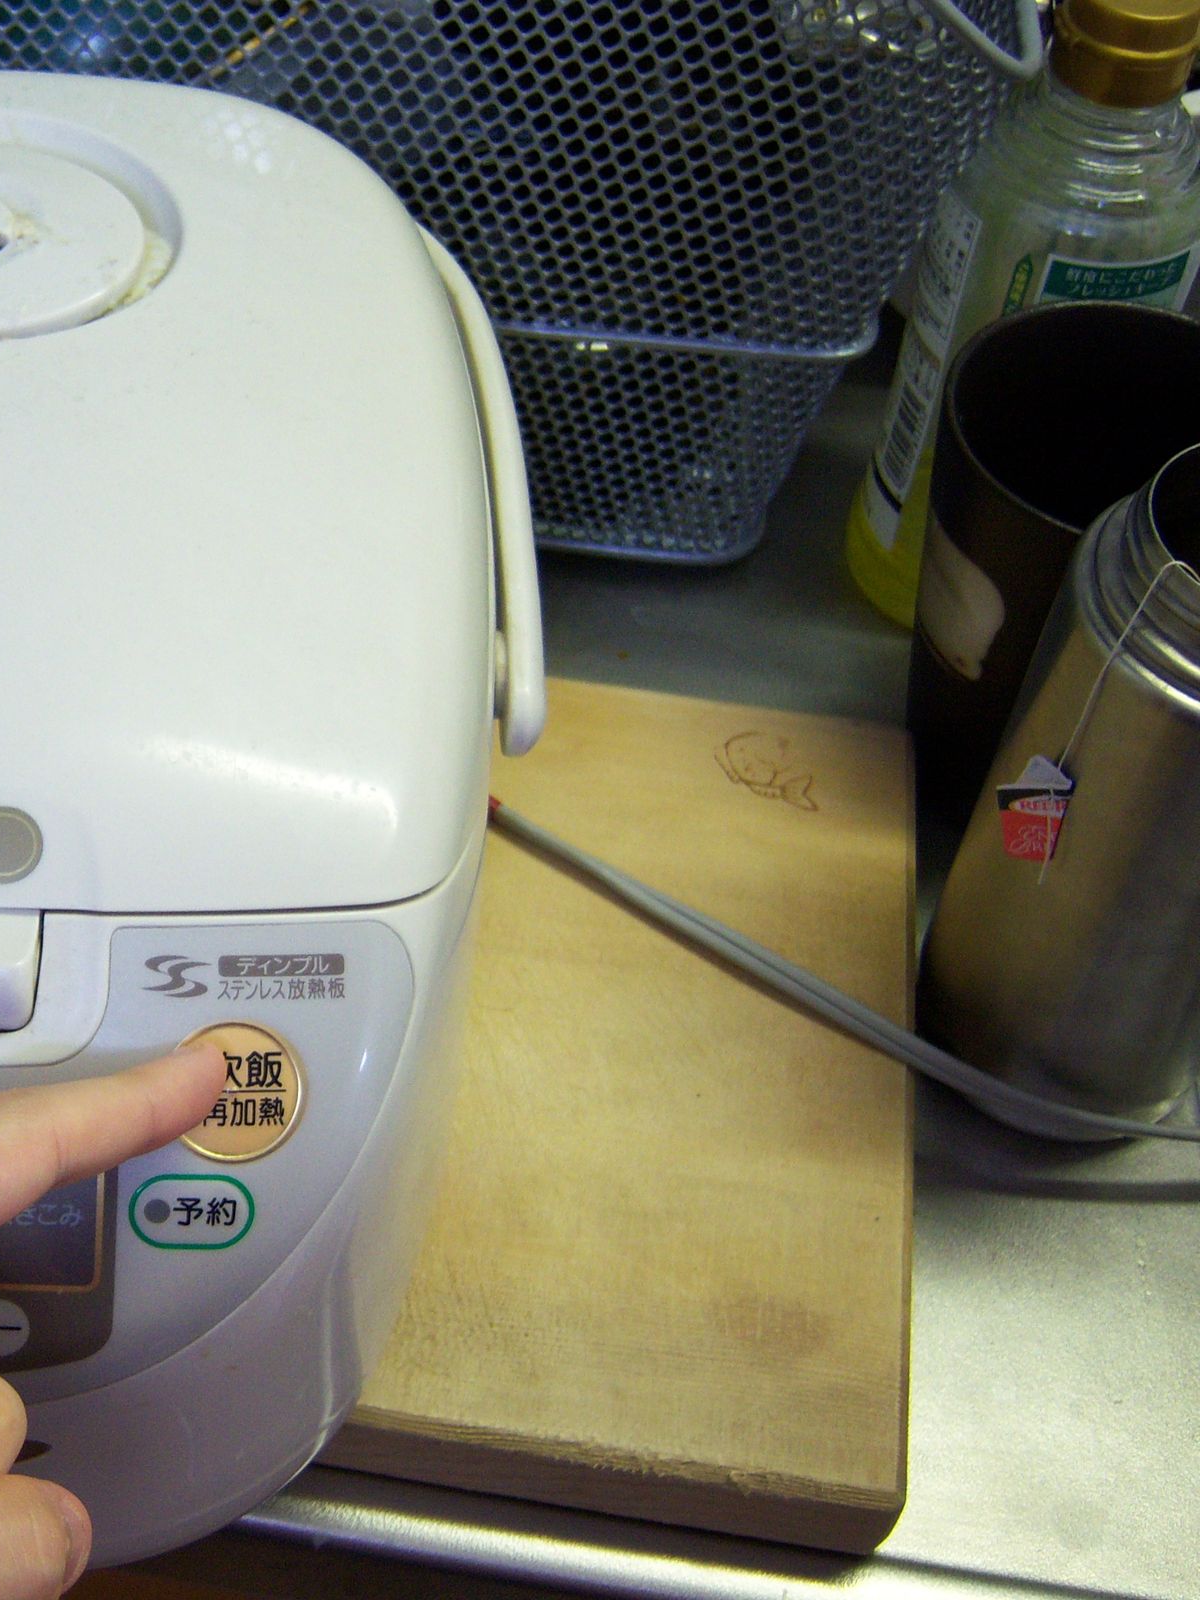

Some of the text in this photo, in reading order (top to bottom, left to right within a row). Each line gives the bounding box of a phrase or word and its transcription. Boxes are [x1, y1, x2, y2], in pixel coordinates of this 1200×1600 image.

[237, 955, 329, 975] ディンプル
[217, 977, 346, 1001] ステンレス放熱板
[173, 1197, 237, 1227] 予約
